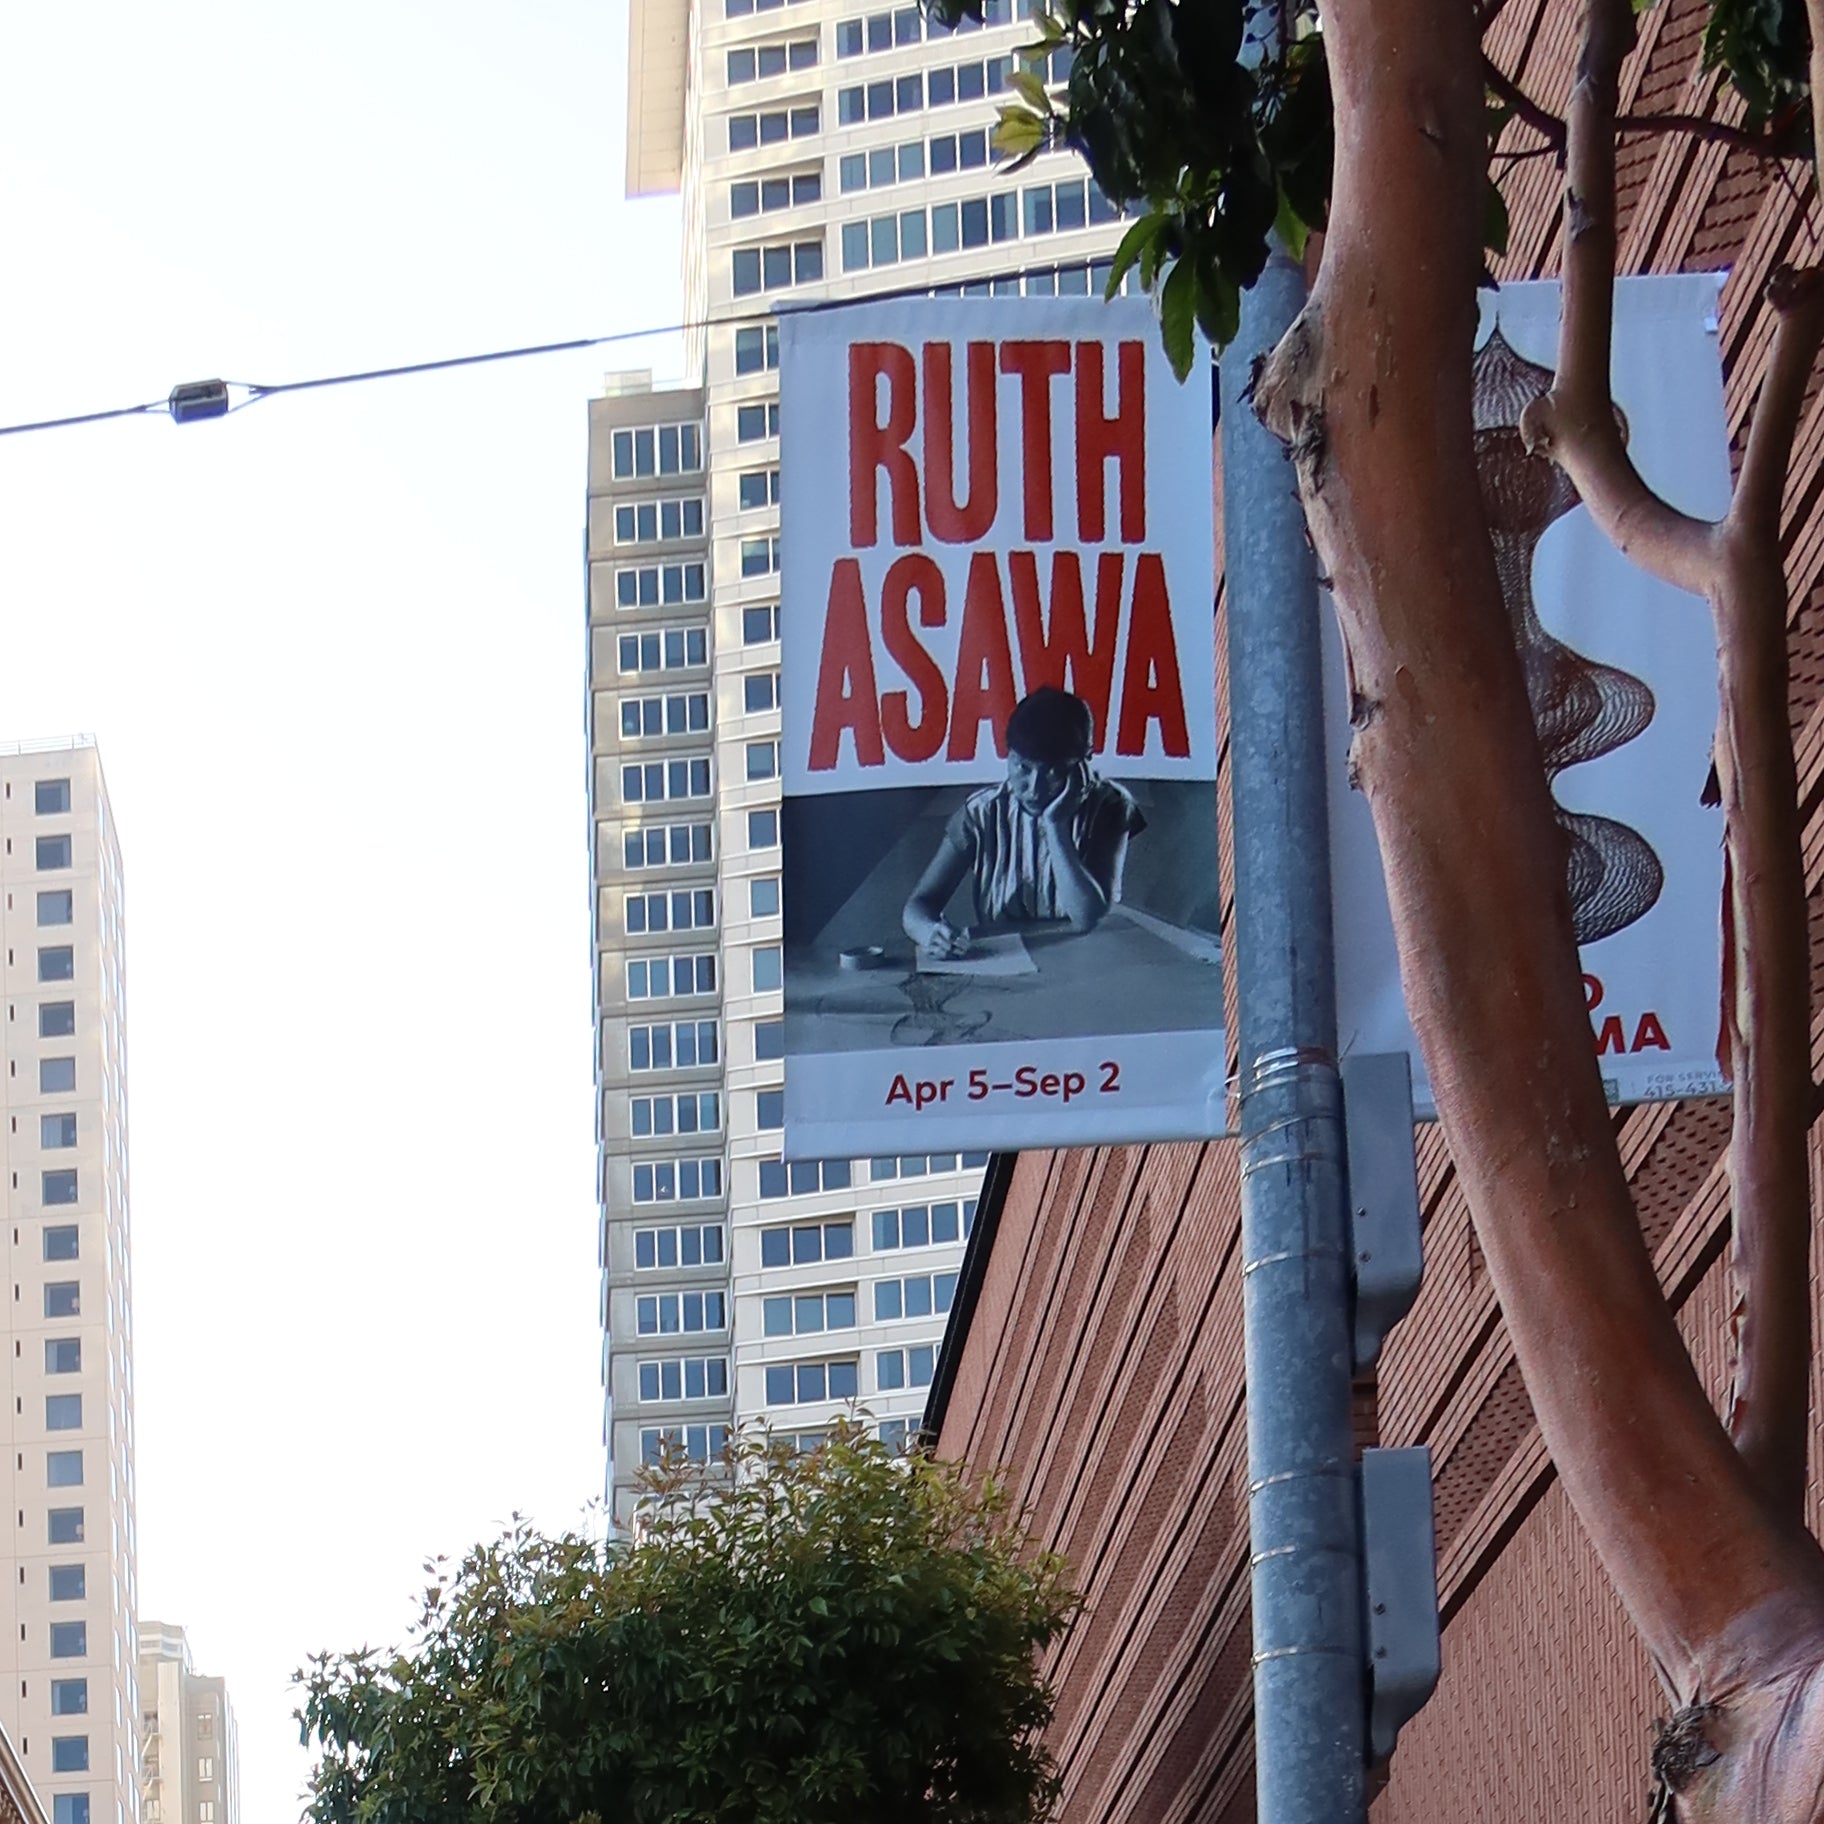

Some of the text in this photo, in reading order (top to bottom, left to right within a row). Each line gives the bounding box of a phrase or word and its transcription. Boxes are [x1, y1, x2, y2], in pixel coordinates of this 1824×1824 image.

[848, 340, 1147, 549] RUTH
[807, 550, 1190, 772] ASAWA
[885, 1071, 953, 1109] Apr
[1098, 1061, 1121, 1094] 2
[1678, 1071, 1721, 1082] SERVI
